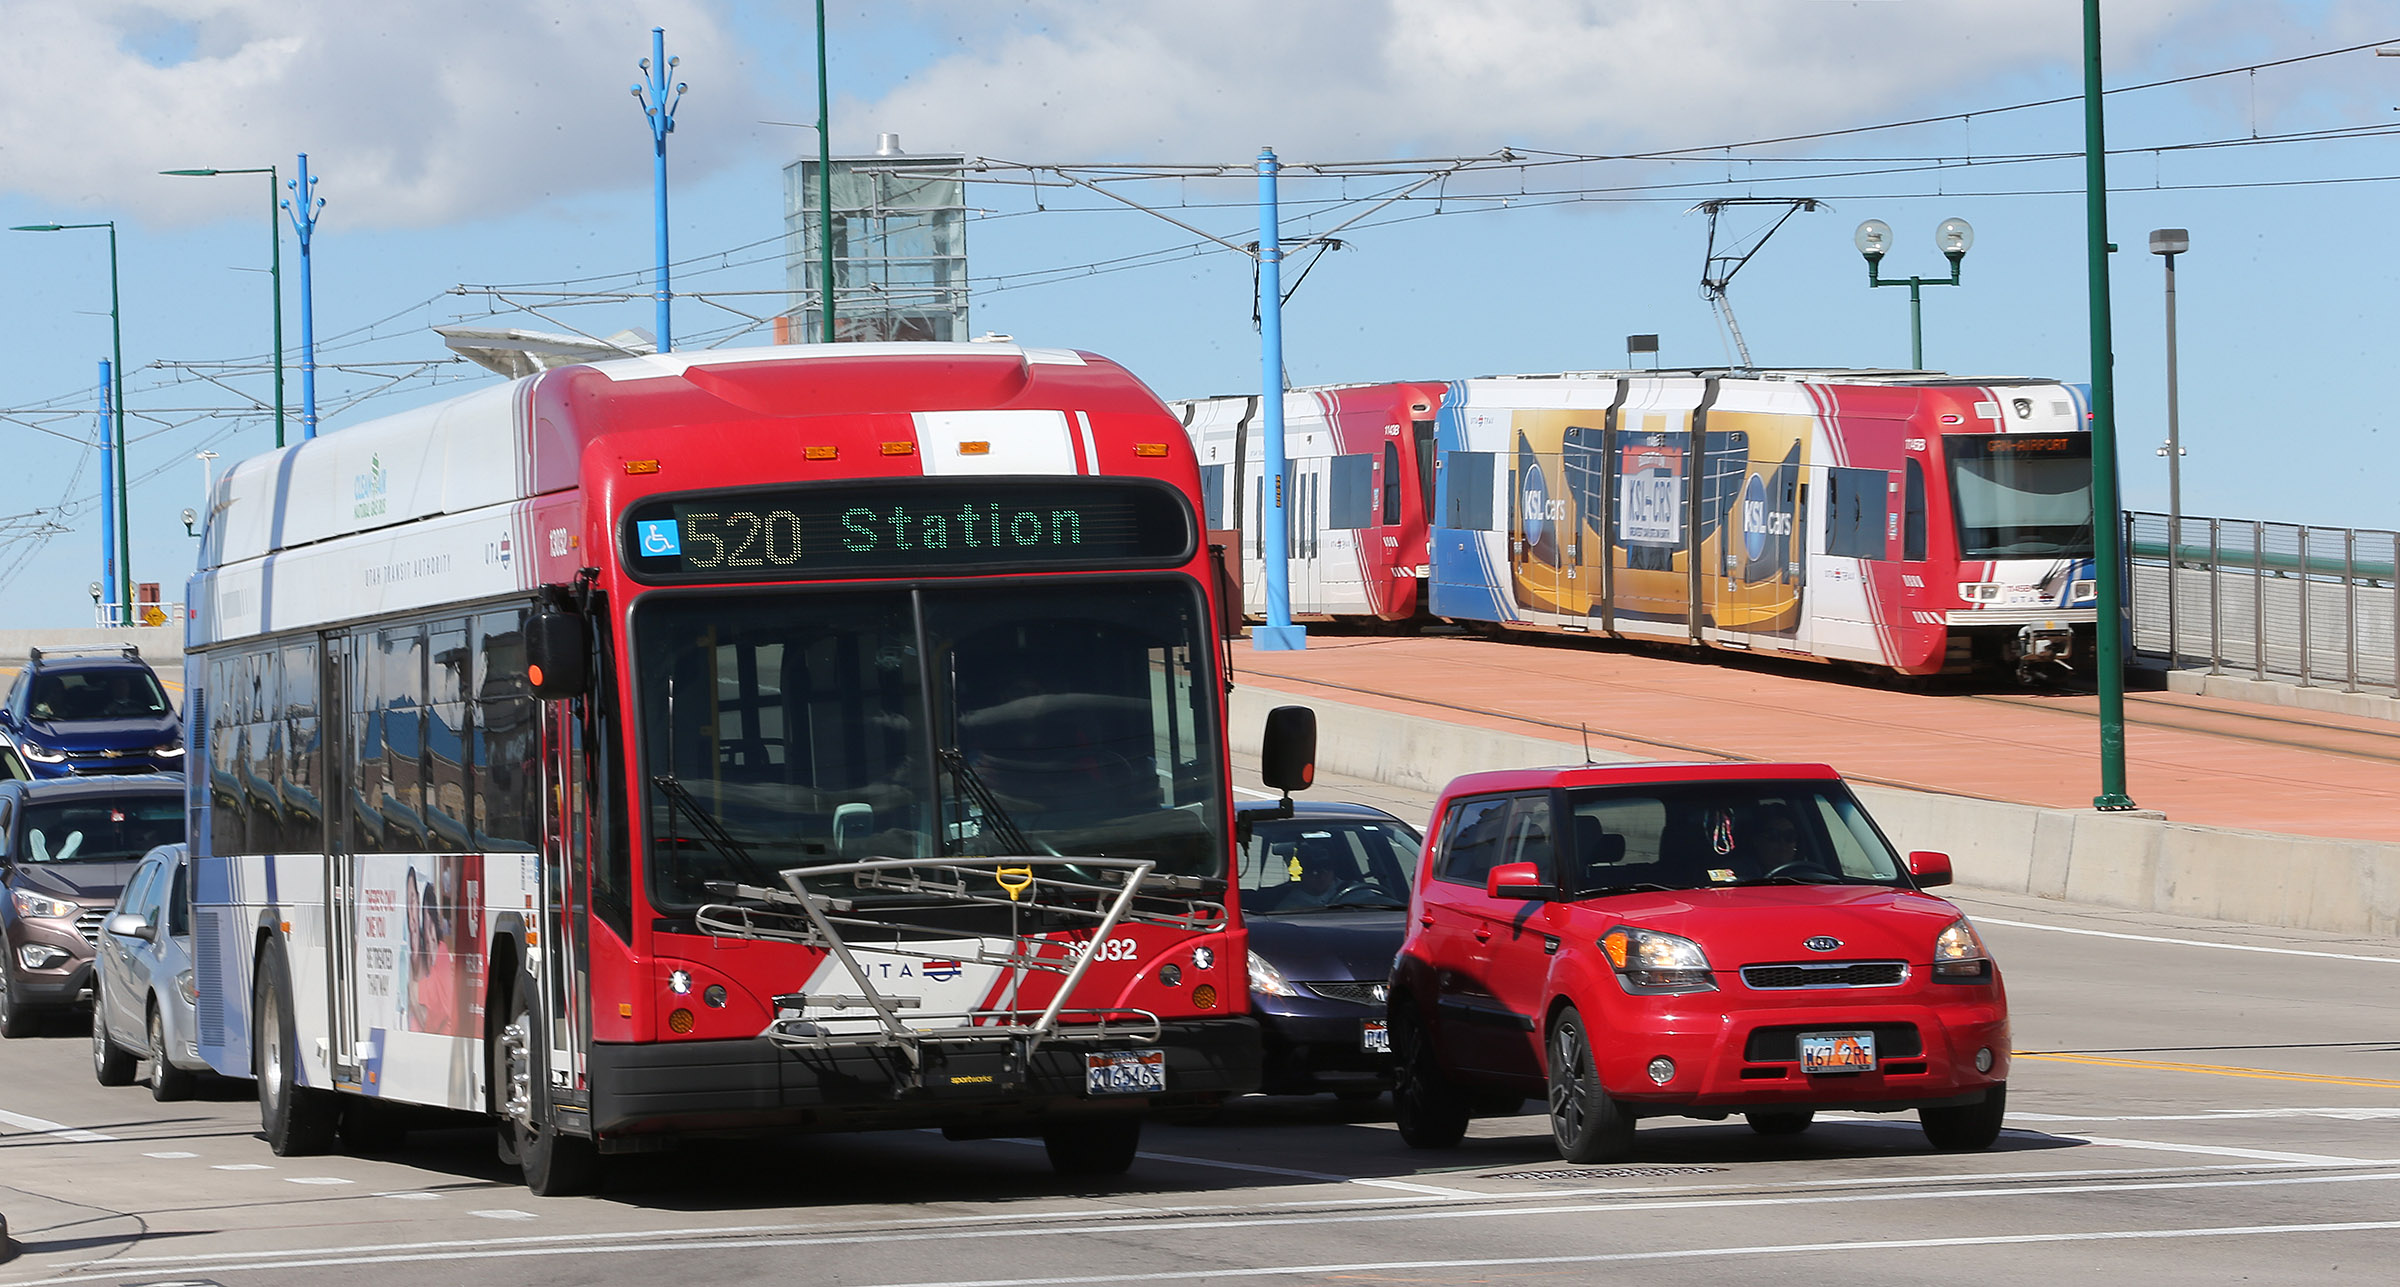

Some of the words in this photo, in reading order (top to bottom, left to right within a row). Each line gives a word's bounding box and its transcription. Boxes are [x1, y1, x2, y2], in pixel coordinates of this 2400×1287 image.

[1525, 490, 1544, 521] KSL
[1545, 499, 1565, 521] cars
[1744, 499, 1767, 534] KSL
[1767, 511, 1792, 536] cars
[686, 508, 803, 569] 520
[841, 502, 1082, 553] Station
[485, 542, 500, 565] UTA
